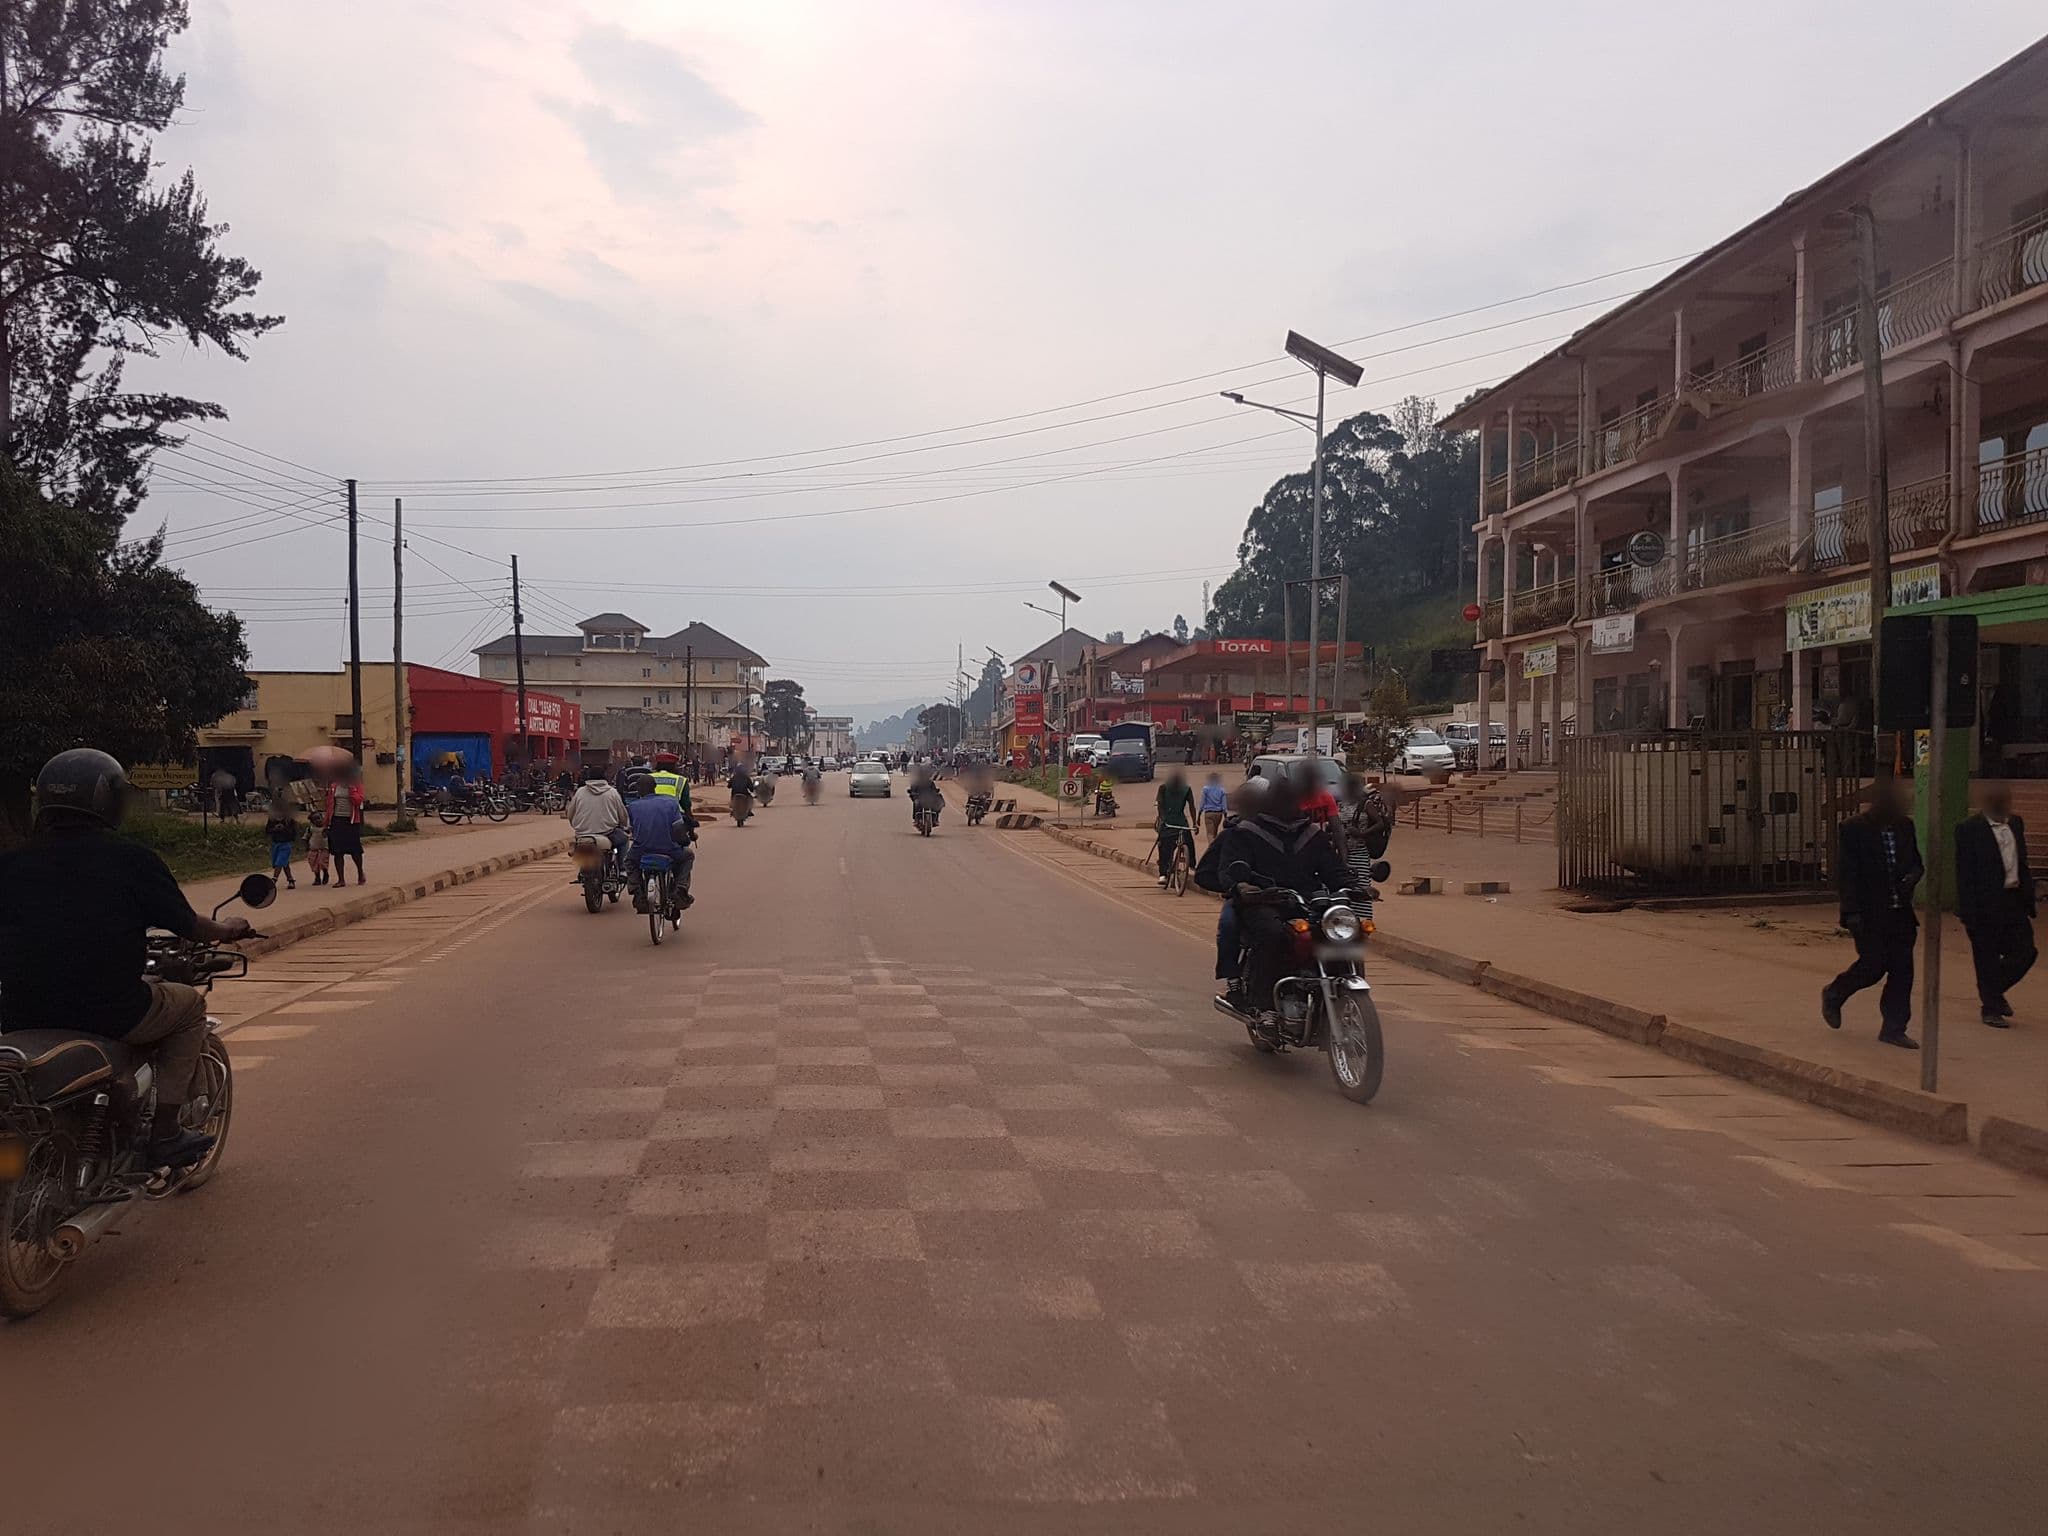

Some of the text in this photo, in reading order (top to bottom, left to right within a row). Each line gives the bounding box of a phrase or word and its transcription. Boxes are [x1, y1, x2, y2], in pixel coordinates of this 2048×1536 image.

[1217, 640, 1271, 653] TOTAL
[528, 698, 539, 714] DIAL
[552, 702, 561, 718] FOR
[529, 716, 544, 732] AIRTEL
[545, 718, 560, 734] MONEY
